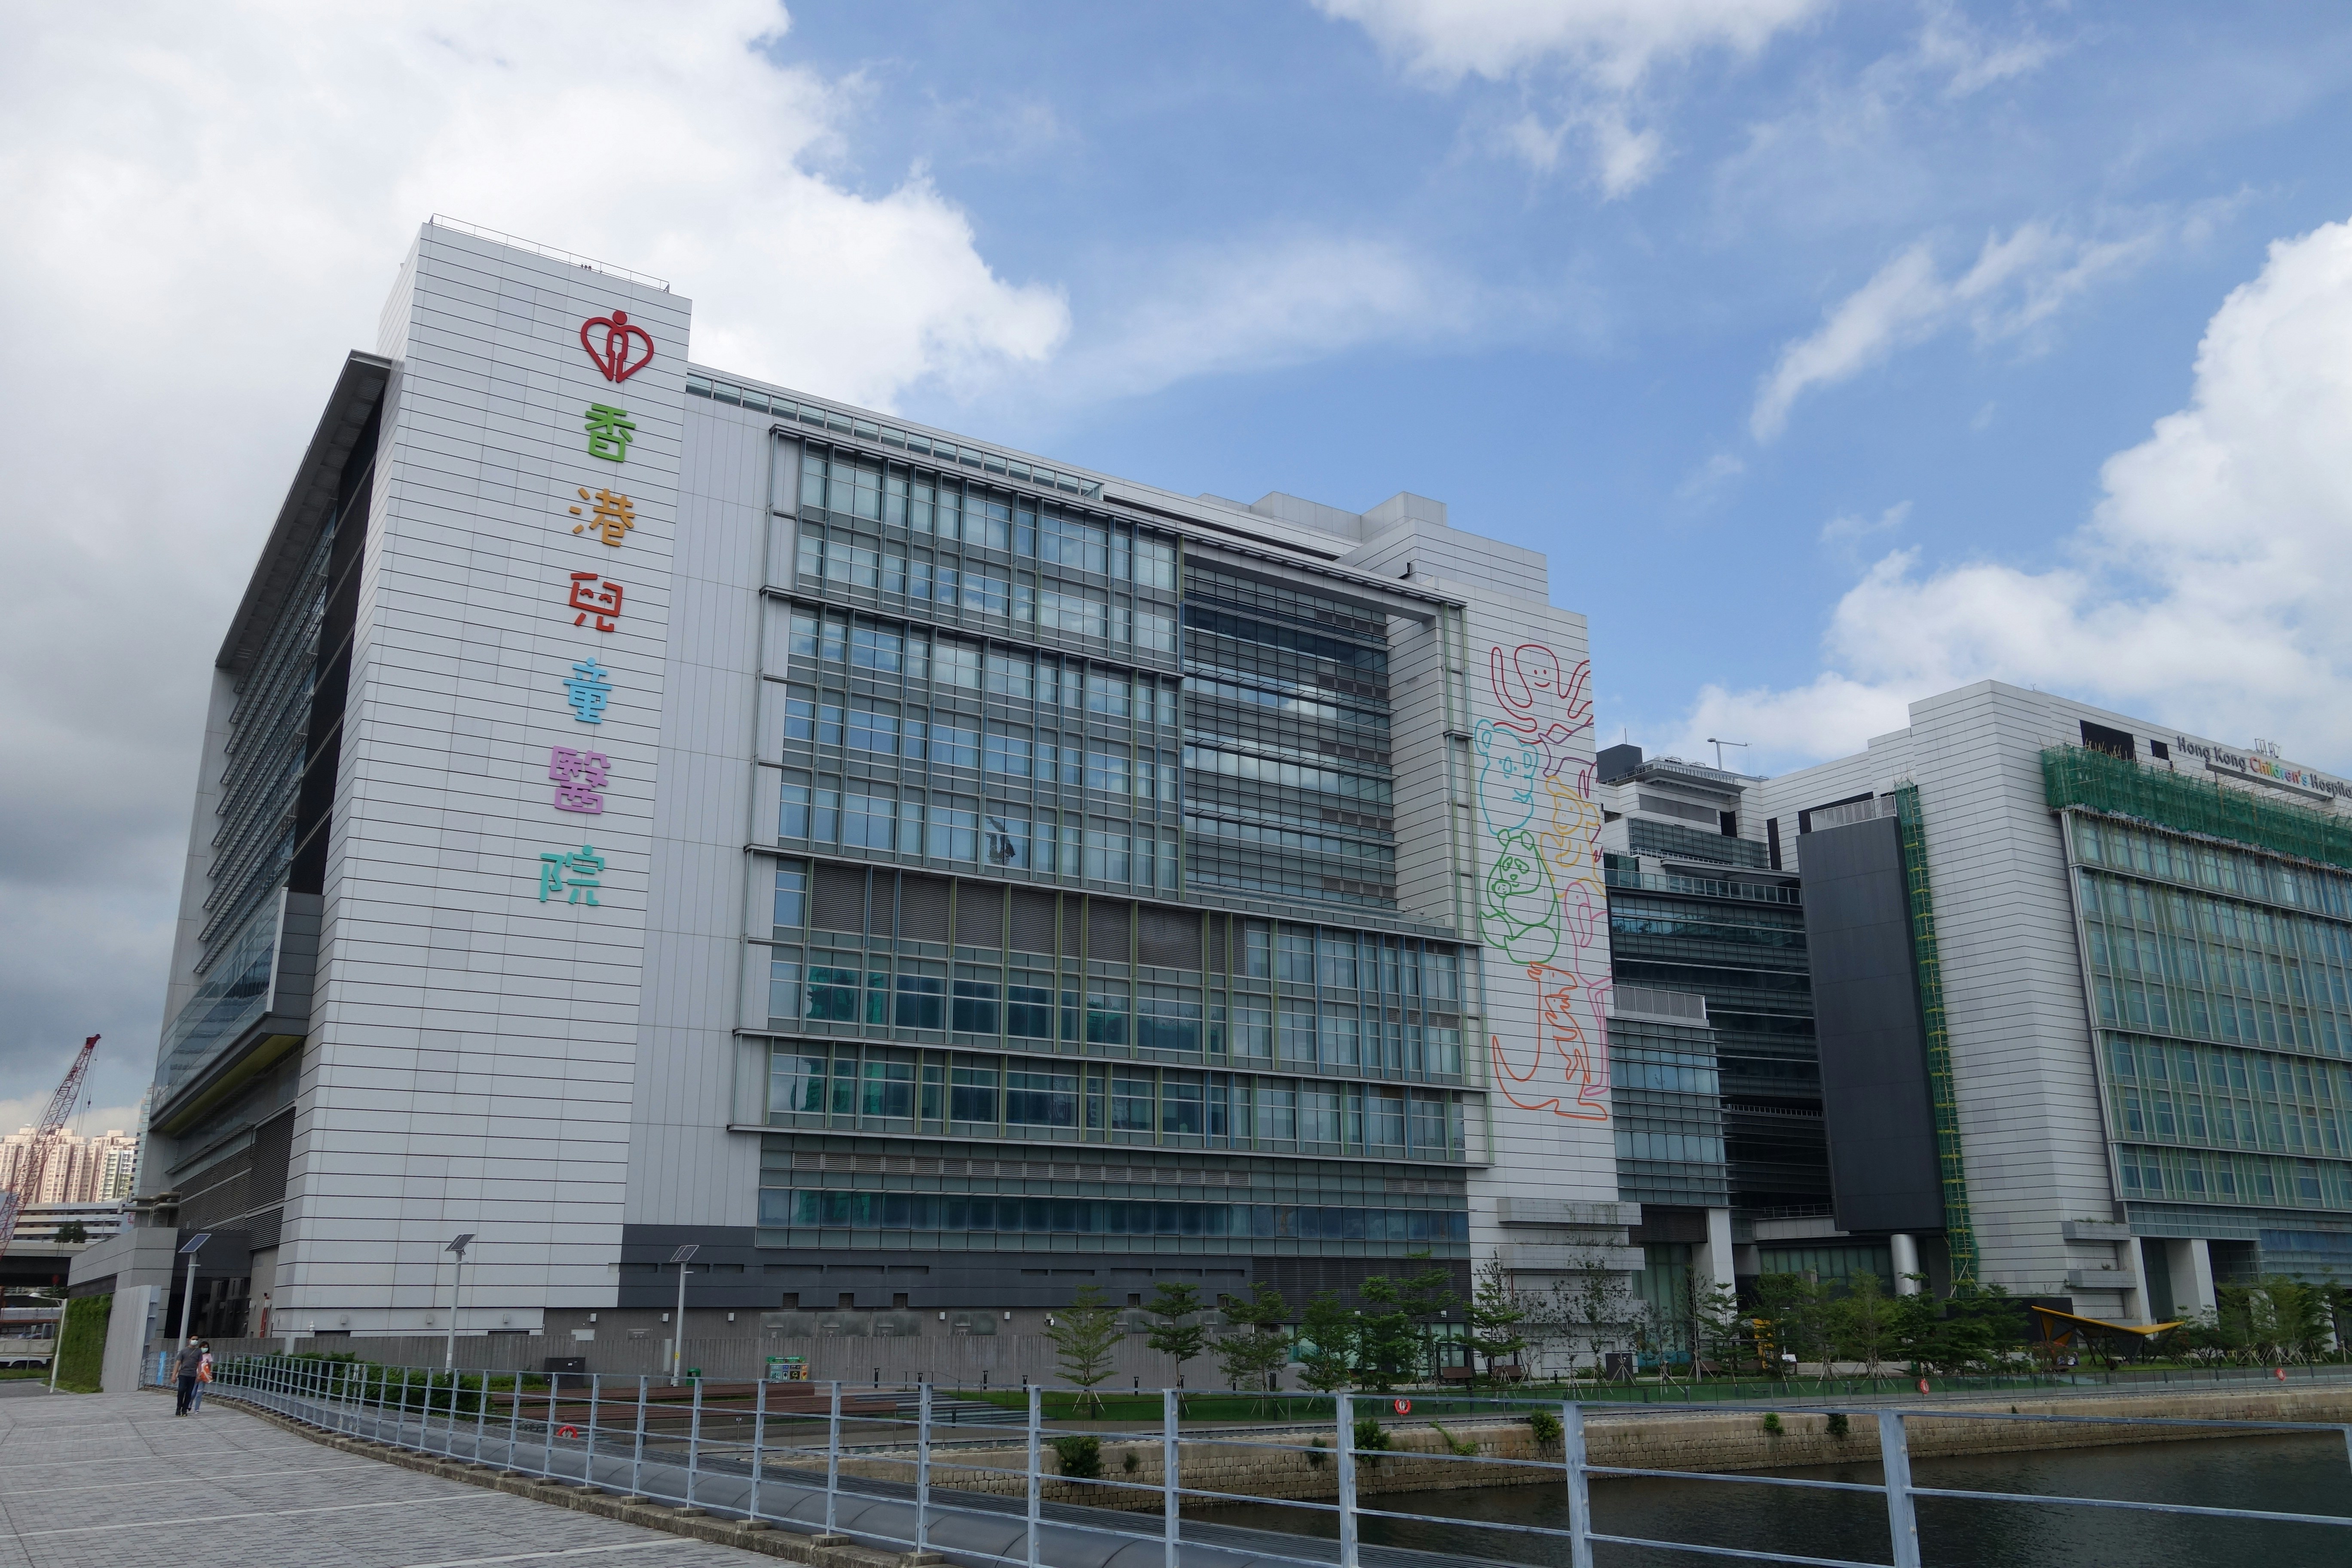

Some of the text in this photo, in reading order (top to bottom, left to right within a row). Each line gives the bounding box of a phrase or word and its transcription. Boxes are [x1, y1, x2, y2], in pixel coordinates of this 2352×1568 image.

[539, 403, 636, 906] 香港兒童醫院
[2177, 736, 2352, 799] Hong Kong Children's Hospita
